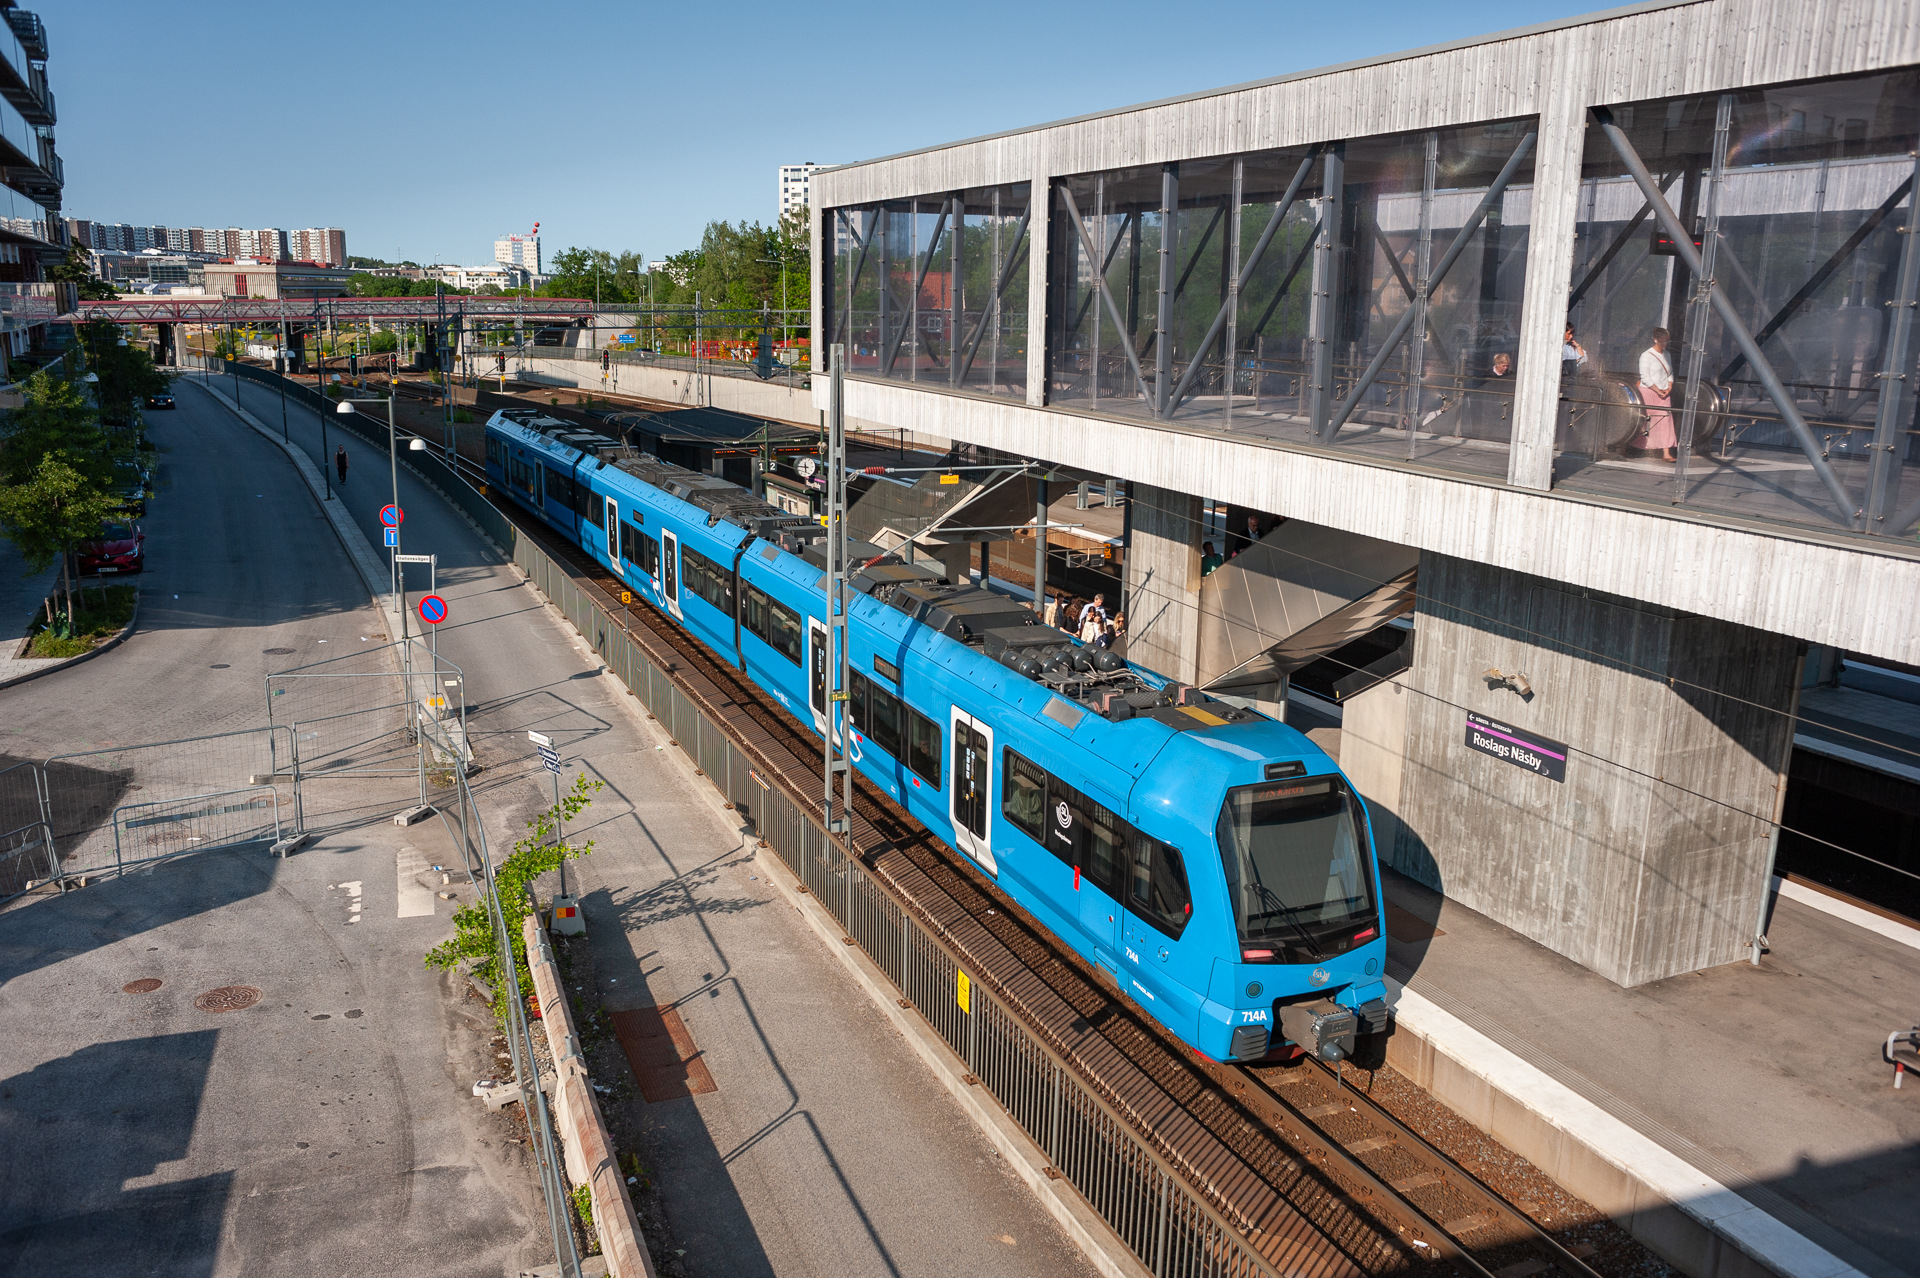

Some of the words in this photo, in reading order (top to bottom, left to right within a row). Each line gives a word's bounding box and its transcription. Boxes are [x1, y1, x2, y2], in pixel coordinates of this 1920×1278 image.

[758, 463, 764, 471] 1
[769, 463, 776, 471] 2
[623, 594, 630, 602] 3
[1473, 732, 1510, 757] Roslags
[1511, 746, 1542, 771] Näsby
[1125, 946, 1139, 965] 714A
[1241, 1009, 1268, 1022] 714A
